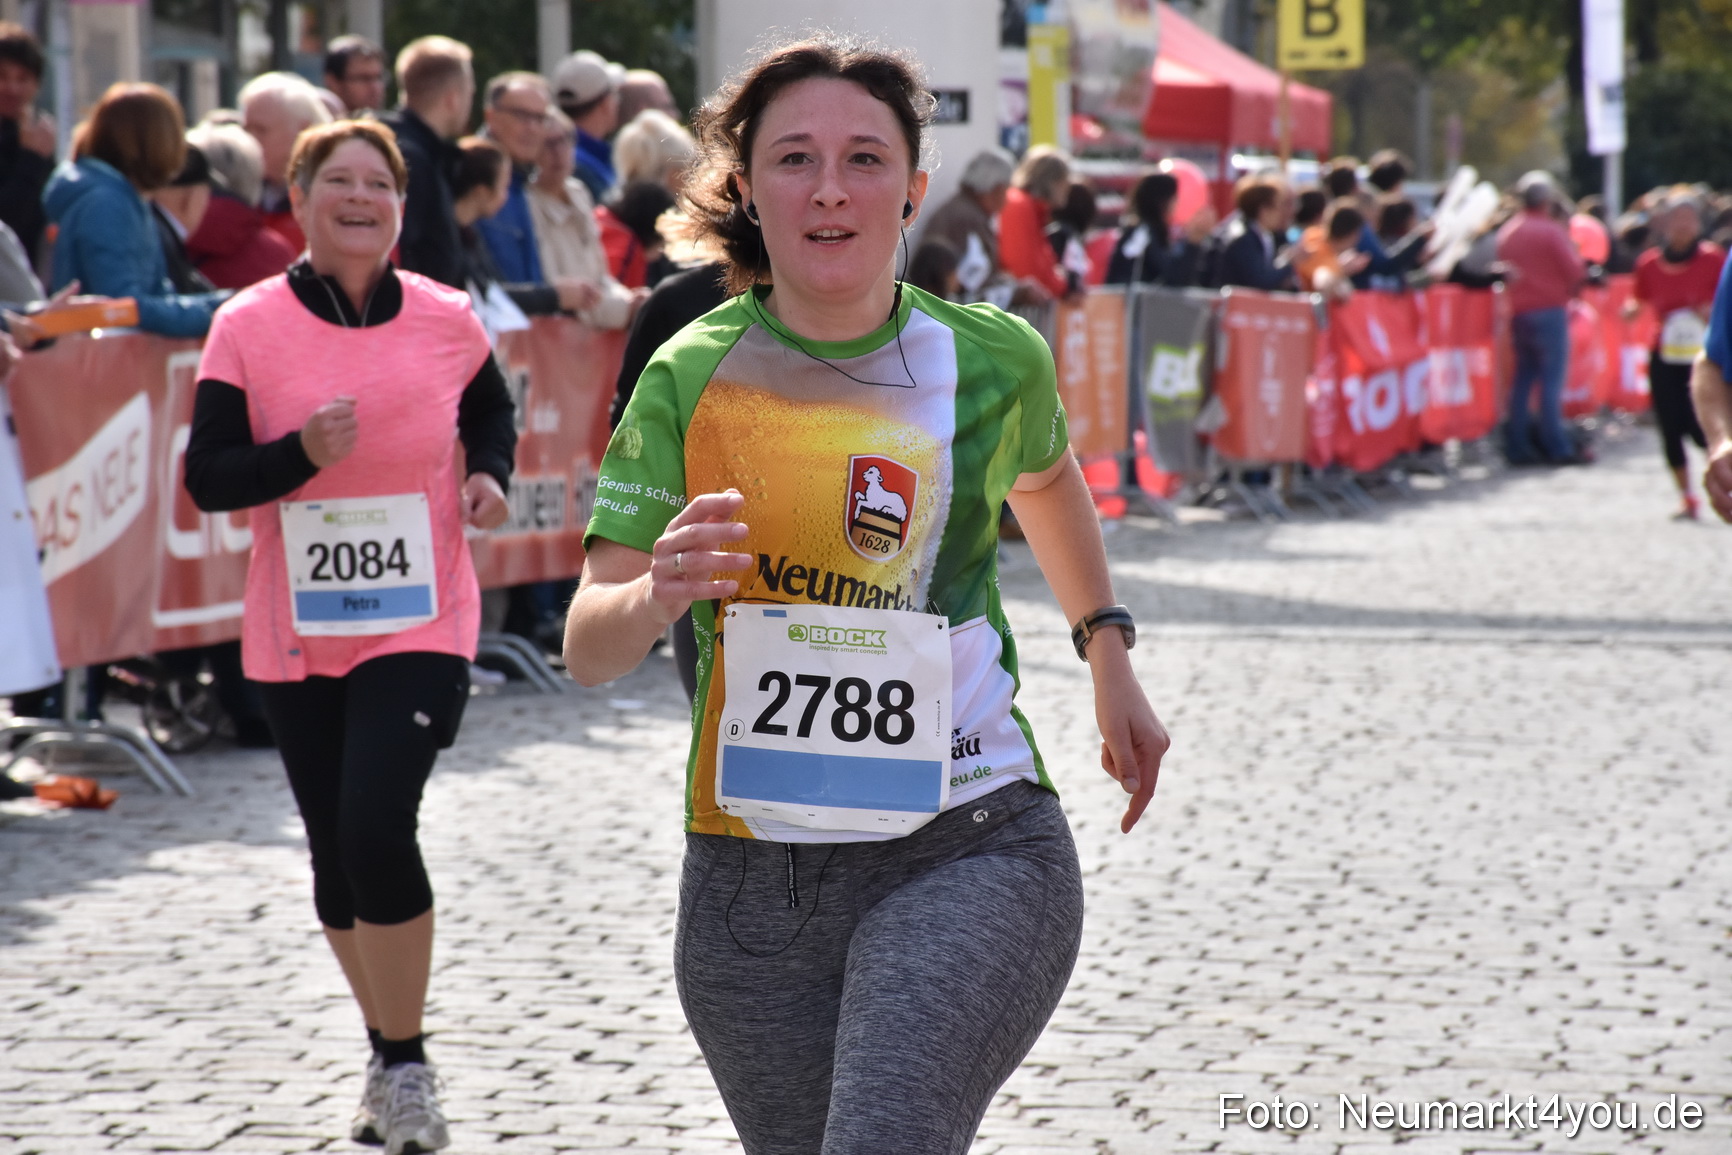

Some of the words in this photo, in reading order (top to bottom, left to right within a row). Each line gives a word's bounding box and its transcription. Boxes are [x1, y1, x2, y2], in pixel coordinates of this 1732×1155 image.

[1303, 0, 1339, 38] B
[598, 475, 642, 494] Genuss
[858, 532, 891, 553] 1628
[307, 537, 411, 582] 2084
[343, 596, 381, 611] Petra
[809, 625, 887, 648] BOCK
[809, 644, 831, 652] inspired
[831, 645, 839, 653] by
[860, 648, 888, 656] concepts
[751, 670, 915, 746] 2788
[731, 724, 739, 736] D
